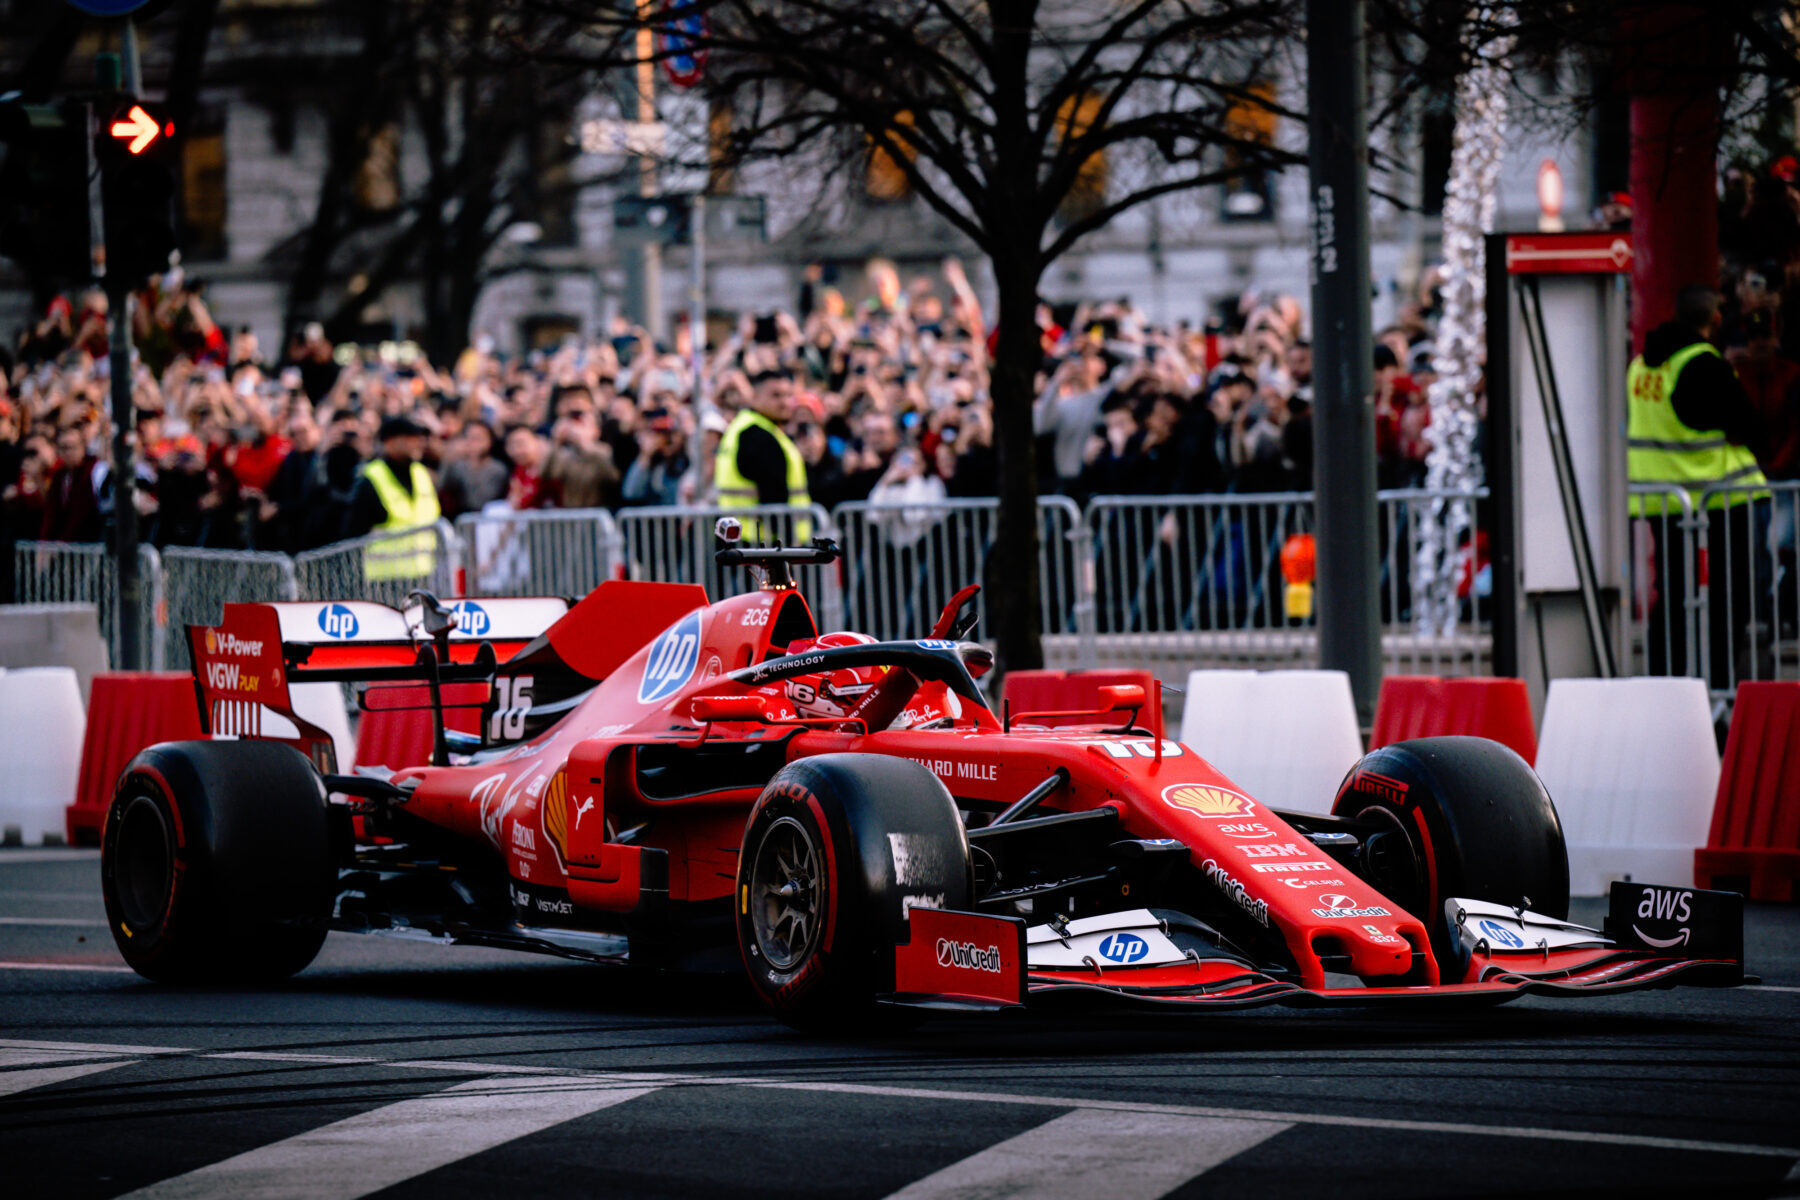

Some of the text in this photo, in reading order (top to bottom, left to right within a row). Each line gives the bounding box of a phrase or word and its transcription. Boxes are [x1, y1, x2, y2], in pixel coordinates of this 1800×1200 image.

[325, 604, 353, 639] hp
[457, 602, 485, 636] hp
[741, 608, 770, 626] ZCG
[217, 634, 263, 657] V-Power
[644, 622, 697, 700] hp
[769, 654, 826, 673] TECHNOLOGY
[206, 662, 260, 692] VGW PLAY
[785, 678, 815, 704] 16
[492, 676, 534, 739] 16
[957, 762, 997, 781] MILLE
[1353, 769, 1409, 806] PIRELLI
[1217, 822, 1269, 833] aws
[1235, 843, 1308, 858] IBM
[1250, 861, 1332, 873] PIRELLI
[1215, 868, 1269, 928] UniCredit
[1312, 906, 1392, 918] UniCredit
[1638, 887, 1693, 923] aws
[1107, 933, 1143, 963] hp
[1370, 935, 1399, 943] 332
[1482, 920, 1518, 948] hp
[950, 939, 1001, 974] UniCredit
